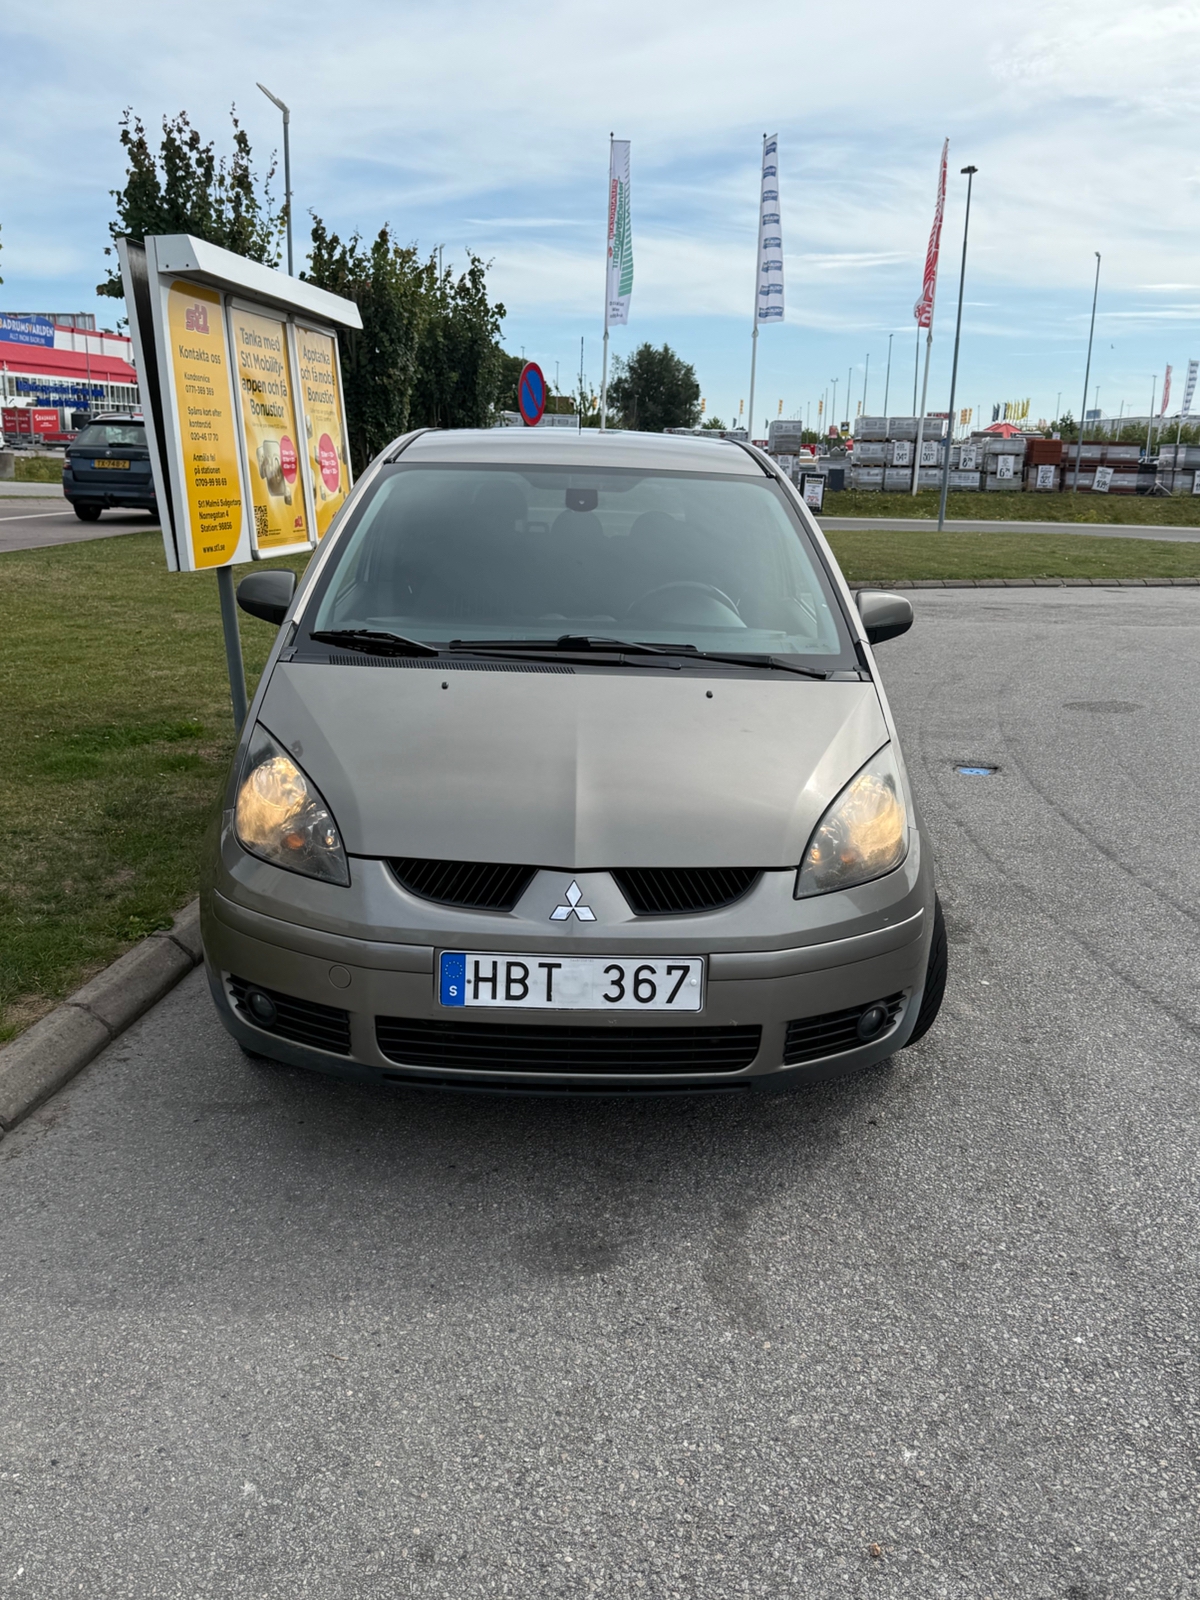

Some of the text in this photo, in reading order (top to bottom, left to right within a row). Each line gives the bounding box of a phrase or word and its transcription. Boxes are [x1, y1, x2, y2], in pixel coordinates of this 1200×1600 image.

[240, 327, 281, 352] Tanka med
[178, 345, 221, 365] Kontakta oss
[303, 345, 330, 365] Apptanka
[240, 350, 284, 377] St1 Mobility-
[184, 372, 210, 383] Kundservice
[300, 366, 311, 381] och
[311, 367, 318, 383] få
[241, 377, 287, 397] appen och få
[202, 406, 212, 416] kort
[212, 408, 222, 417] efter
[250, 398, 285, 419] Bonustior
[189, 419, 212, 428] kontorstid
[193, 453, 209, 462] Anmäla
[194, 465, 221, 475] på stationen
[205, 499, 220, 508] Malmö
[225, 510, 229, 518] 4
[202, 544, 225, 553] www.st1.se
[473, 960, 690, 1003] HBT 367
[449, 985, 458, 997] S
